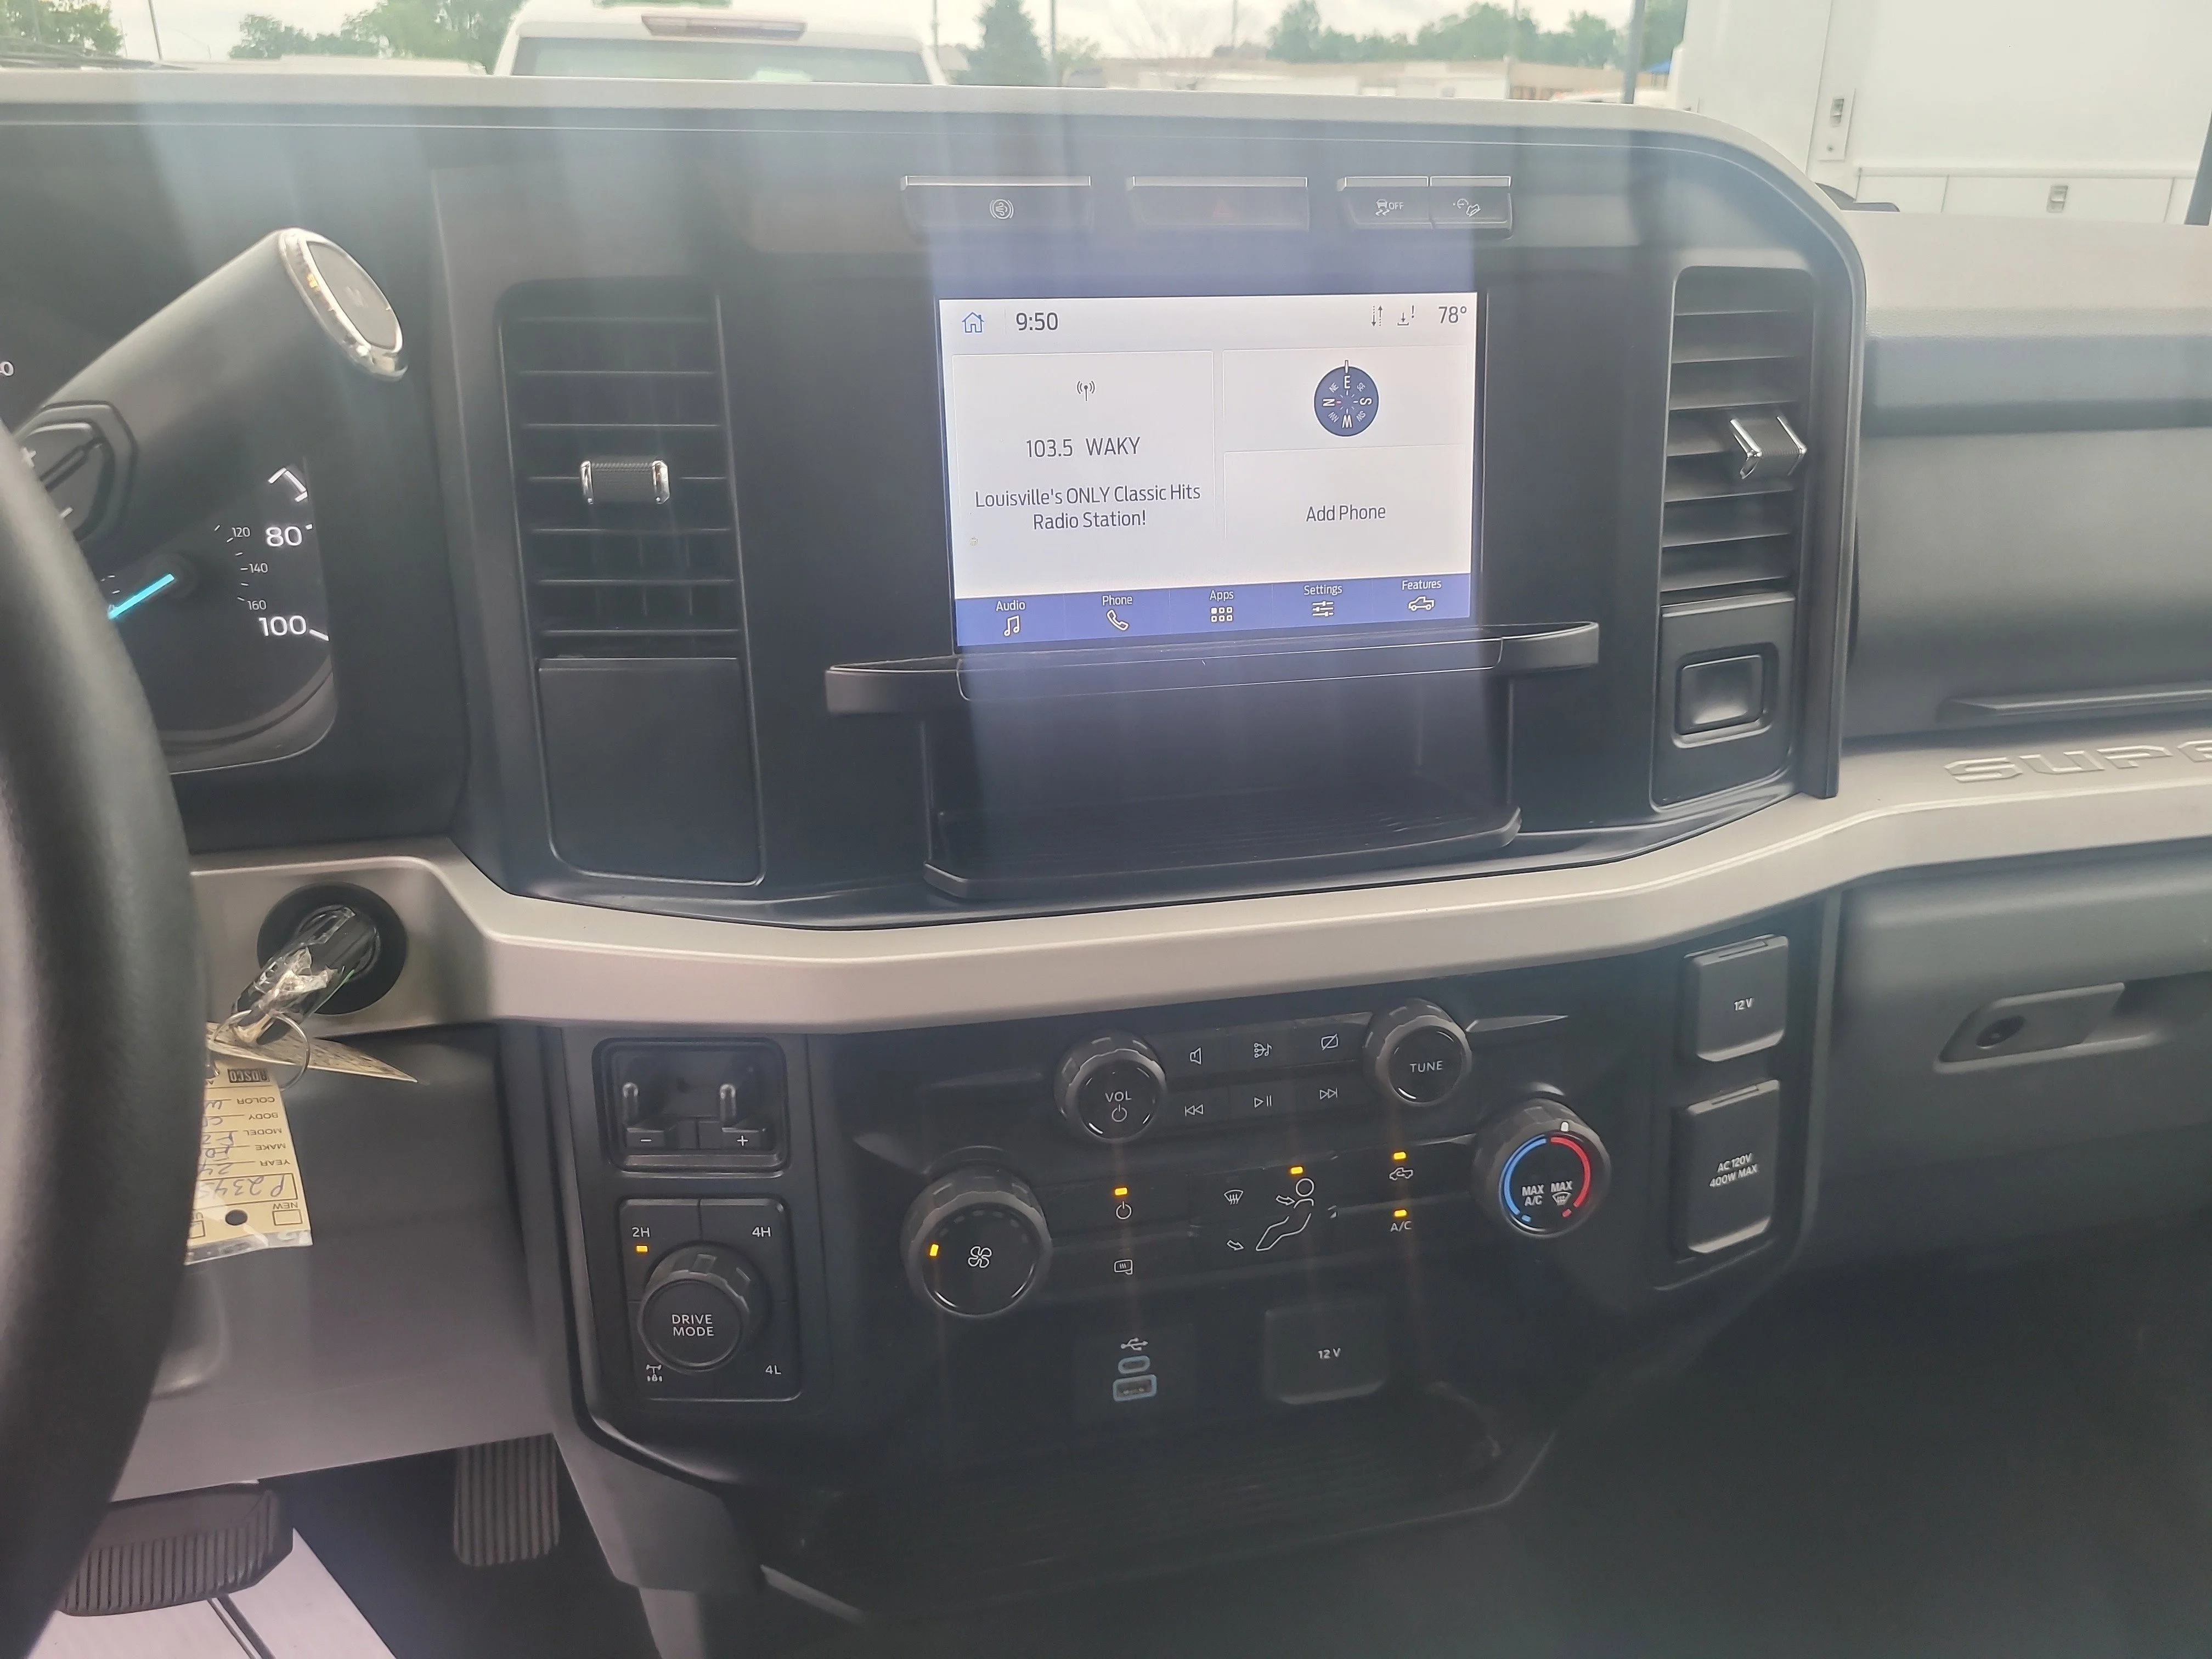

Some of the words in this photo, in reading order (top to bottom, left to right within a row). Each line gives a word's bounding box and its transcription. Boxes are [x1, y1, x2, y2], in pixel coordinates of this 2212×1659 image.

[1389, 202, 1403, 210] OFF
[1439, 306, 1466, 325] 78°
[1017, 313, 1058, 330] 9:50
[1344, 375, 1350, 388] E
[1027, 439, 1074, 457] 103.5
[1086, 437, 1140, 455] WAKY
[976, 487, 1062, 507] Louisville's
[1067, 487, 1110, 503] ONLY
[1115, 485, 1166, 501] Classic
[1171, 484, 1200, 499] Hits
[1306, 505, 1335, 521] Add
[1340, 503, 1385, 520] Phone
[1034, 512, 1078, 529] Radio
[1083, 510, 1145, 527] Station!
[232, 527, 250, 538] 120
[266, 527, 302, 546] 80
[250, 562, 268, 573] 140
[1402, 578, 1441, 590] Features
[1210, 589, 1233, 601] Apps
[1304, 583, 1342, 597] Settings
[247, 600, 266, 610] 160
[996, 600, 1025, 611] Audio
[1103, 595, 1132, 606] Phone
[259, 616, 306, 636] 100
[1410, 1061, 1442, 1072] TUNE
[1105, 1091, 1131, 1102] VOL
[1718, 1159, 1731, 1173] AC
[1731, 1153, 1752, 1169] 120V
[1709, 1170, 1737, 1187] 400W
[1737, 1164, 1757, 1178] MAX
[1522, 1185, 1544, 1197] MAX
[1551, 1181, 1572, 1192] MAX
[1524, 1195, 1544, 1206] A/C
[632, 1227, 650, 1237] 2H
[753, 1227, 770, 1237] 4H
[1391, 1221, 1411, 1232] A/C
[672, 1314, 712, 1324] DRIVE
[674, 1325, 714, 1336] MODE
[1318, 1350, 1330, 1358] 12
[766, 1365, 781, 1374] 4L
